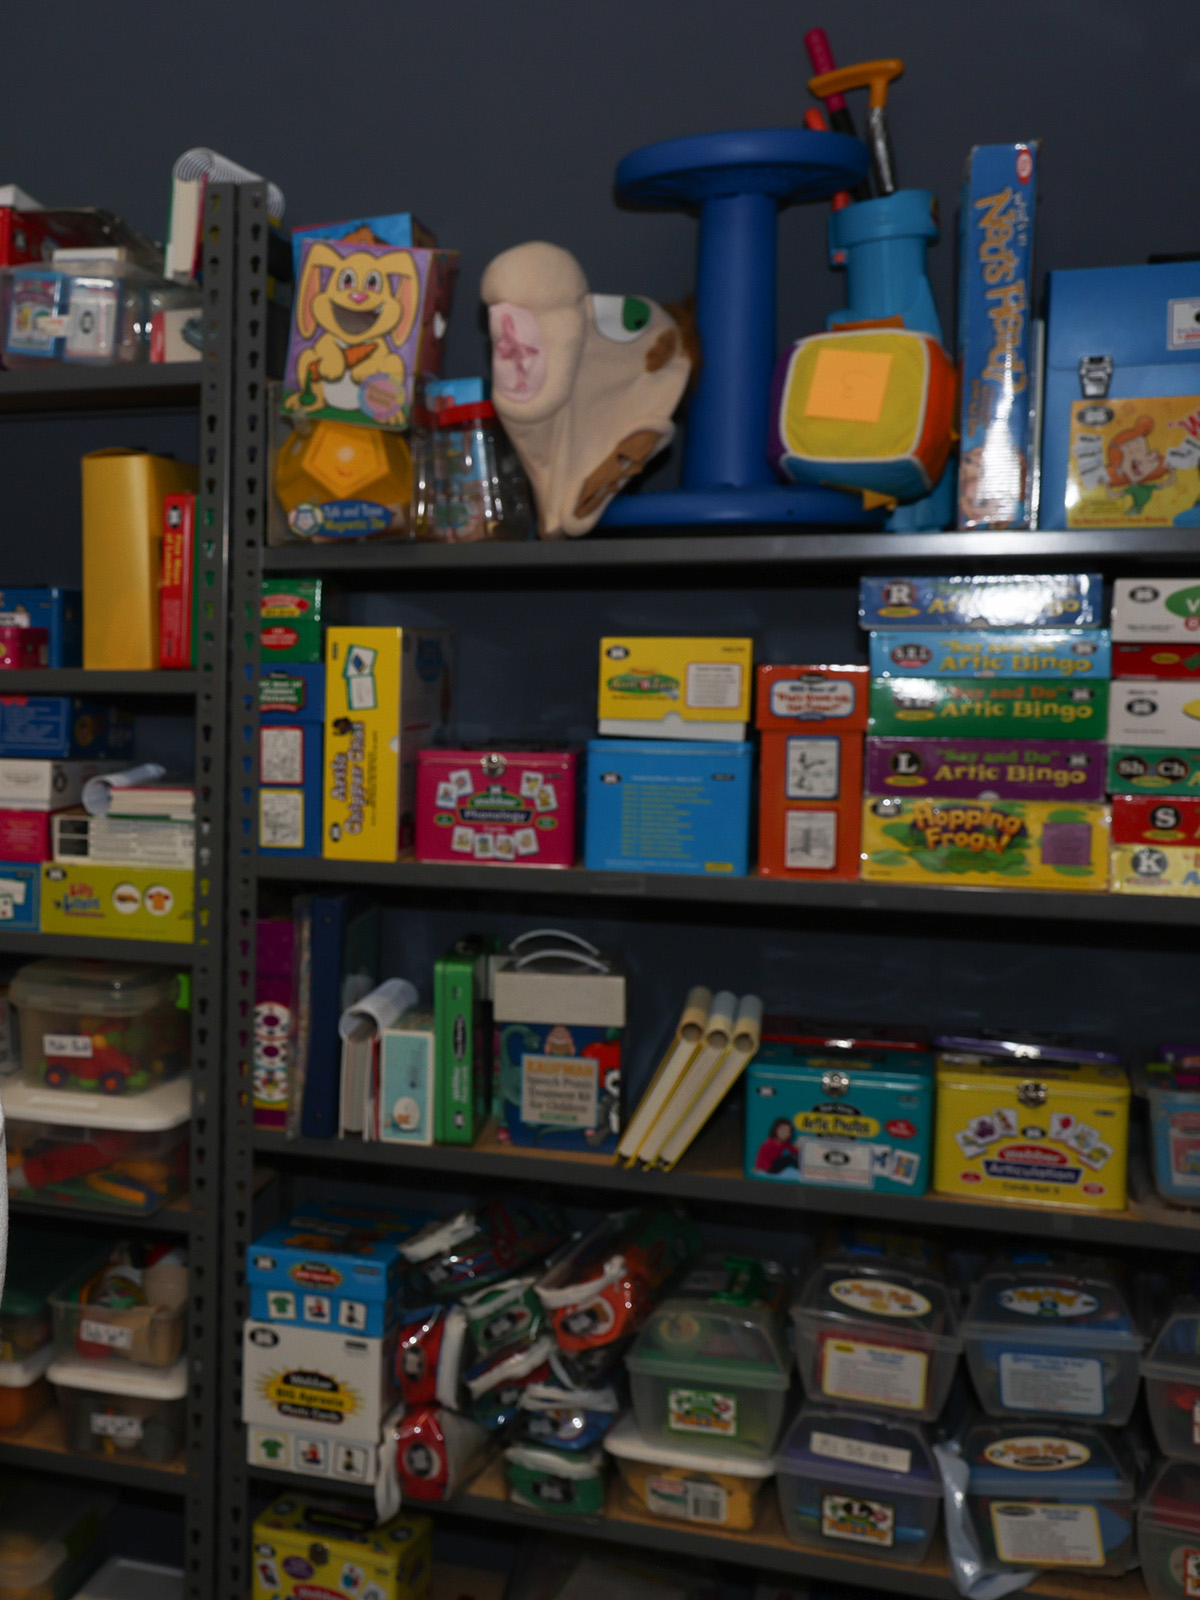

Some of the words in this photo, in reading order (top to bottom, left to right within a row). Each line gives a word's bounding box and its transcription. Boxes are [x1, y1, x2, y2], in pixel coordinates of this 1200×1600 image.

[974, 186, 1019, 284] Ned's
[889, 585, 910, 605] R
[938, 655, 1003, 671] Artic
[1011, 656, 1093, 676] Bingo
[989, 685, 1025, 699] and
[940, 700, 1007, 718] Artic
[1012, 702, 1095, 722] Bingo
[897, 752, 919, 775] L
[983, 750, 1019, 763] and
[934, 764, 1001, 782] Artic
[1006, 765, 1088, 788] Bingo
[913, 800, 1024, 837] Hopping
[1154, 807, 1177, 829] S
[925, 825, 1011, 855] Frogs!
[1137, 851, 1163, 874] K
